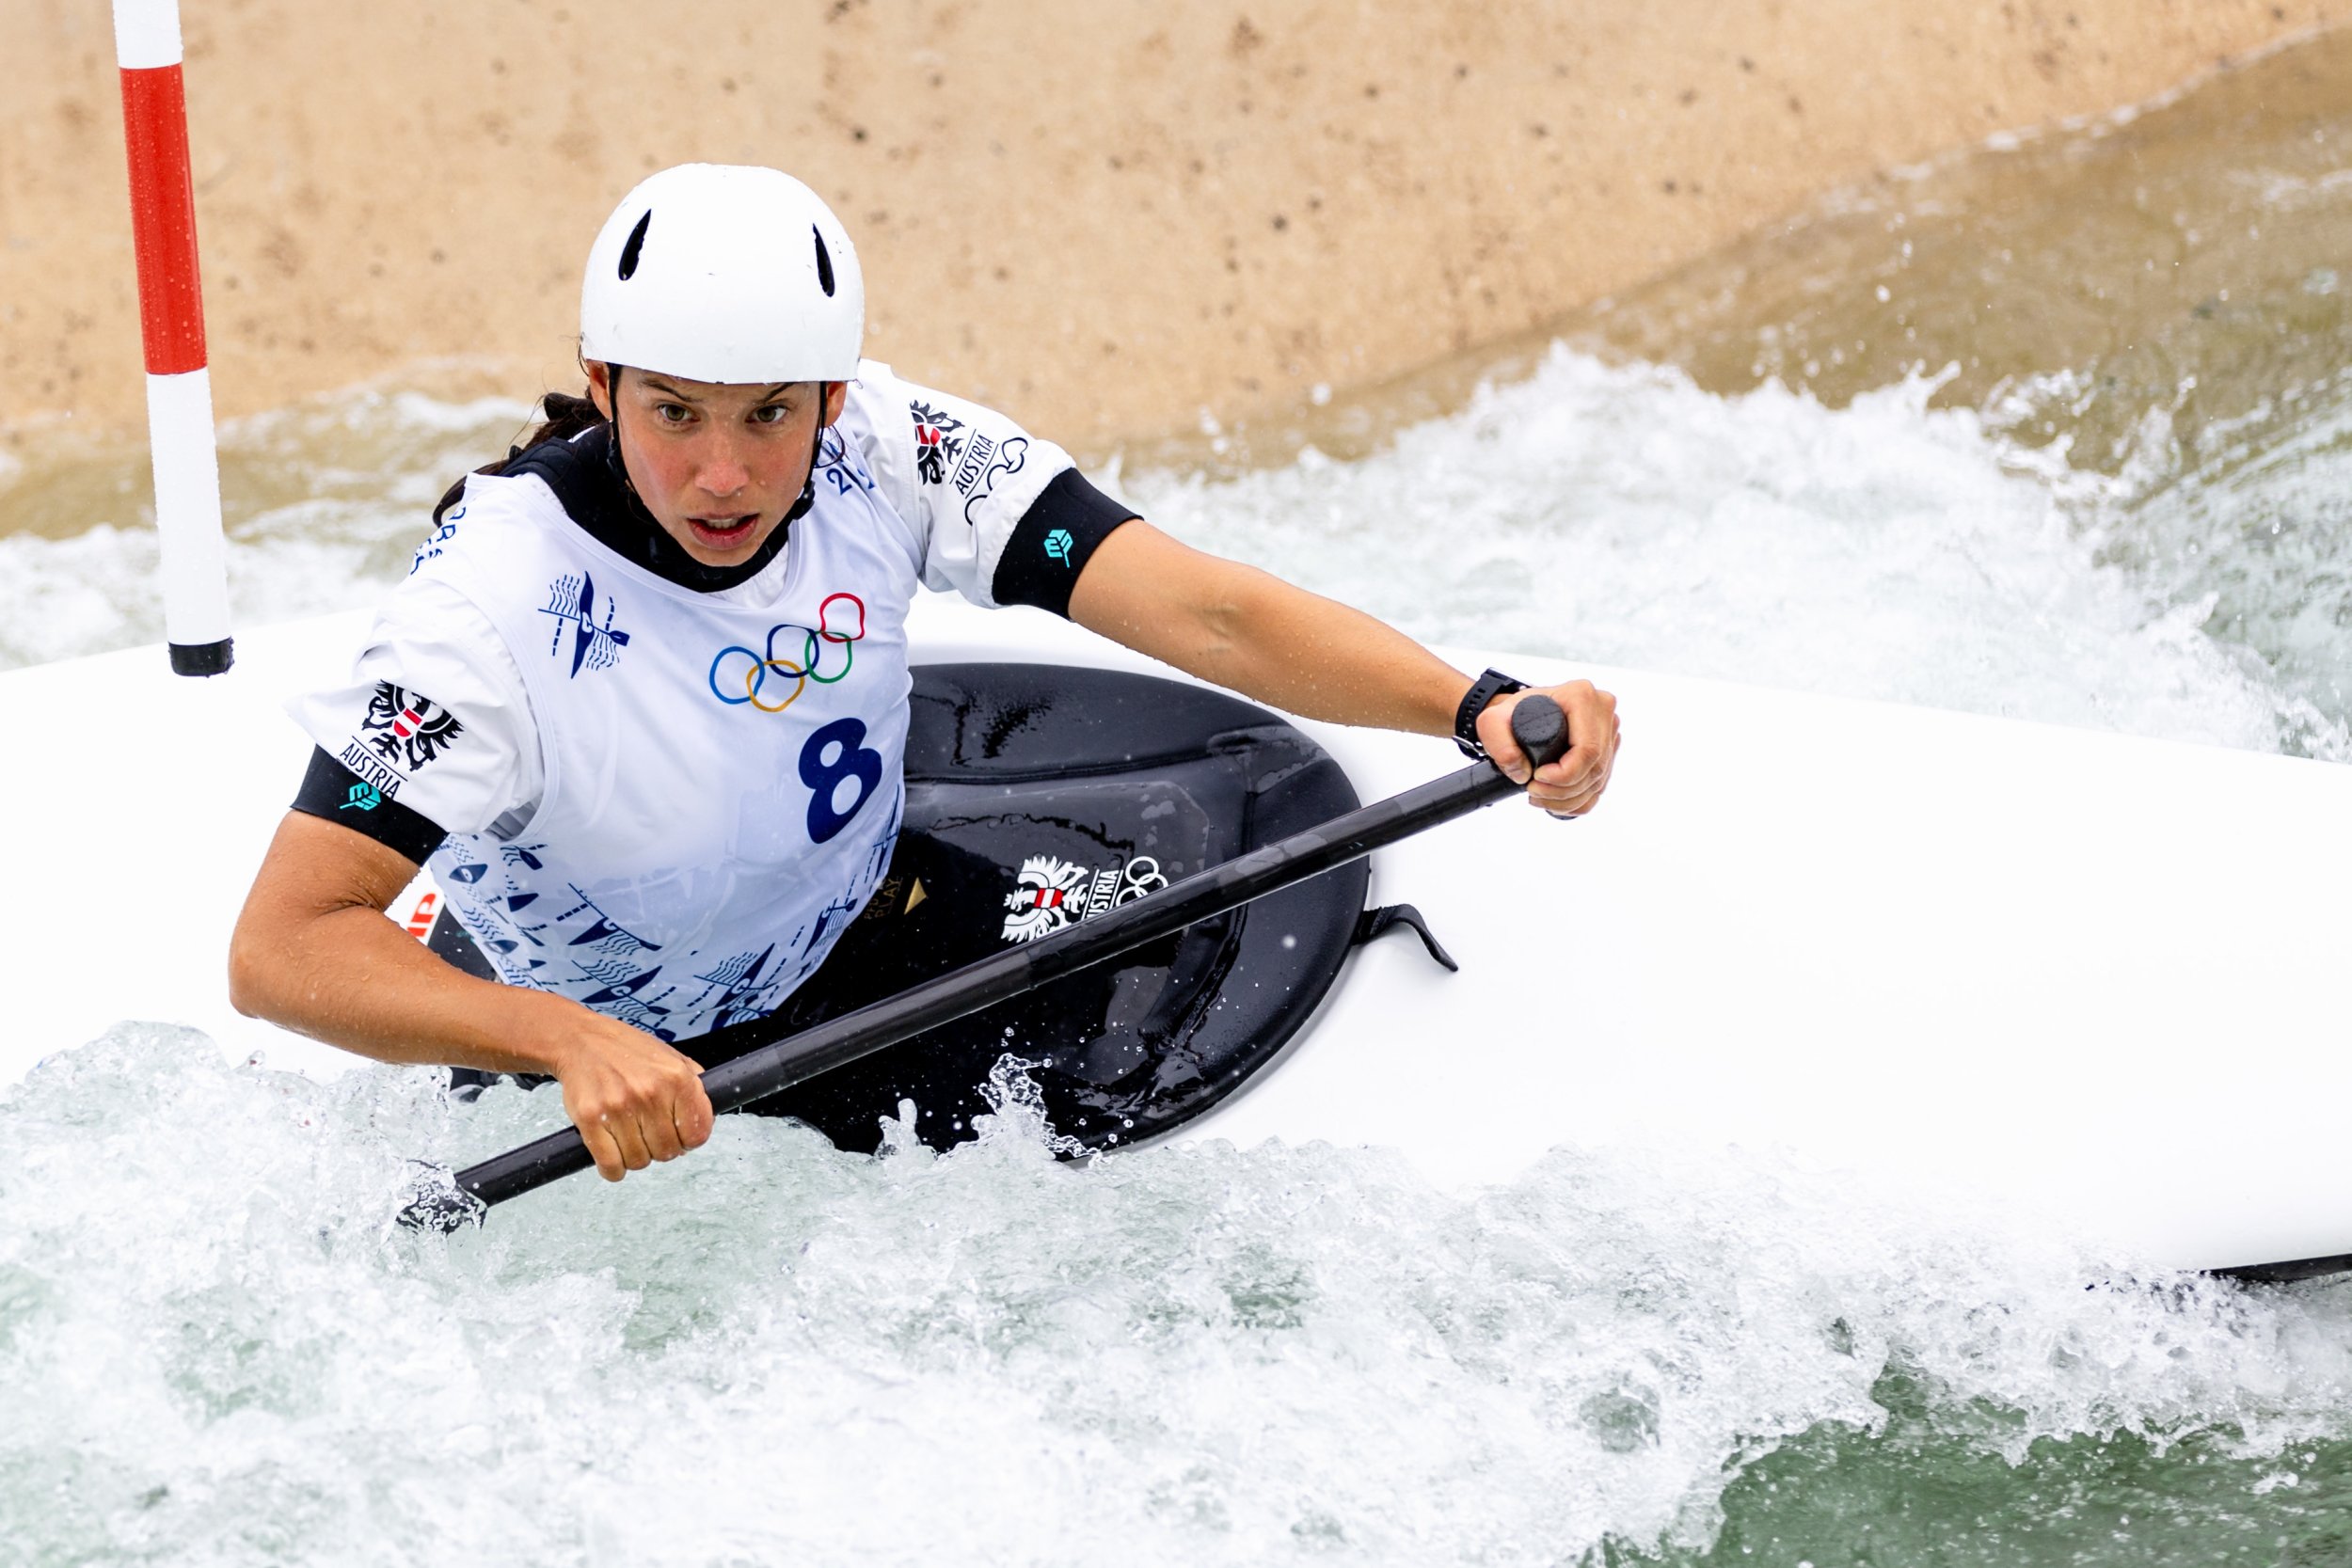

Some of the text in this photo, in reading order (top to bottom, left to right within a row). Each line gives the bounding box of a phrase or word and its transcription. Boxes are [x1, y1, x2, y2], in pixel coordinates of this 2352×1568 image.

[955, 434, 994, 495] AUSTRIA
[339, 742, 402, 800] AUSTRIA
[798, 717, 882, 844] 8
[1086, 869, 1120, 919] USTRIA
